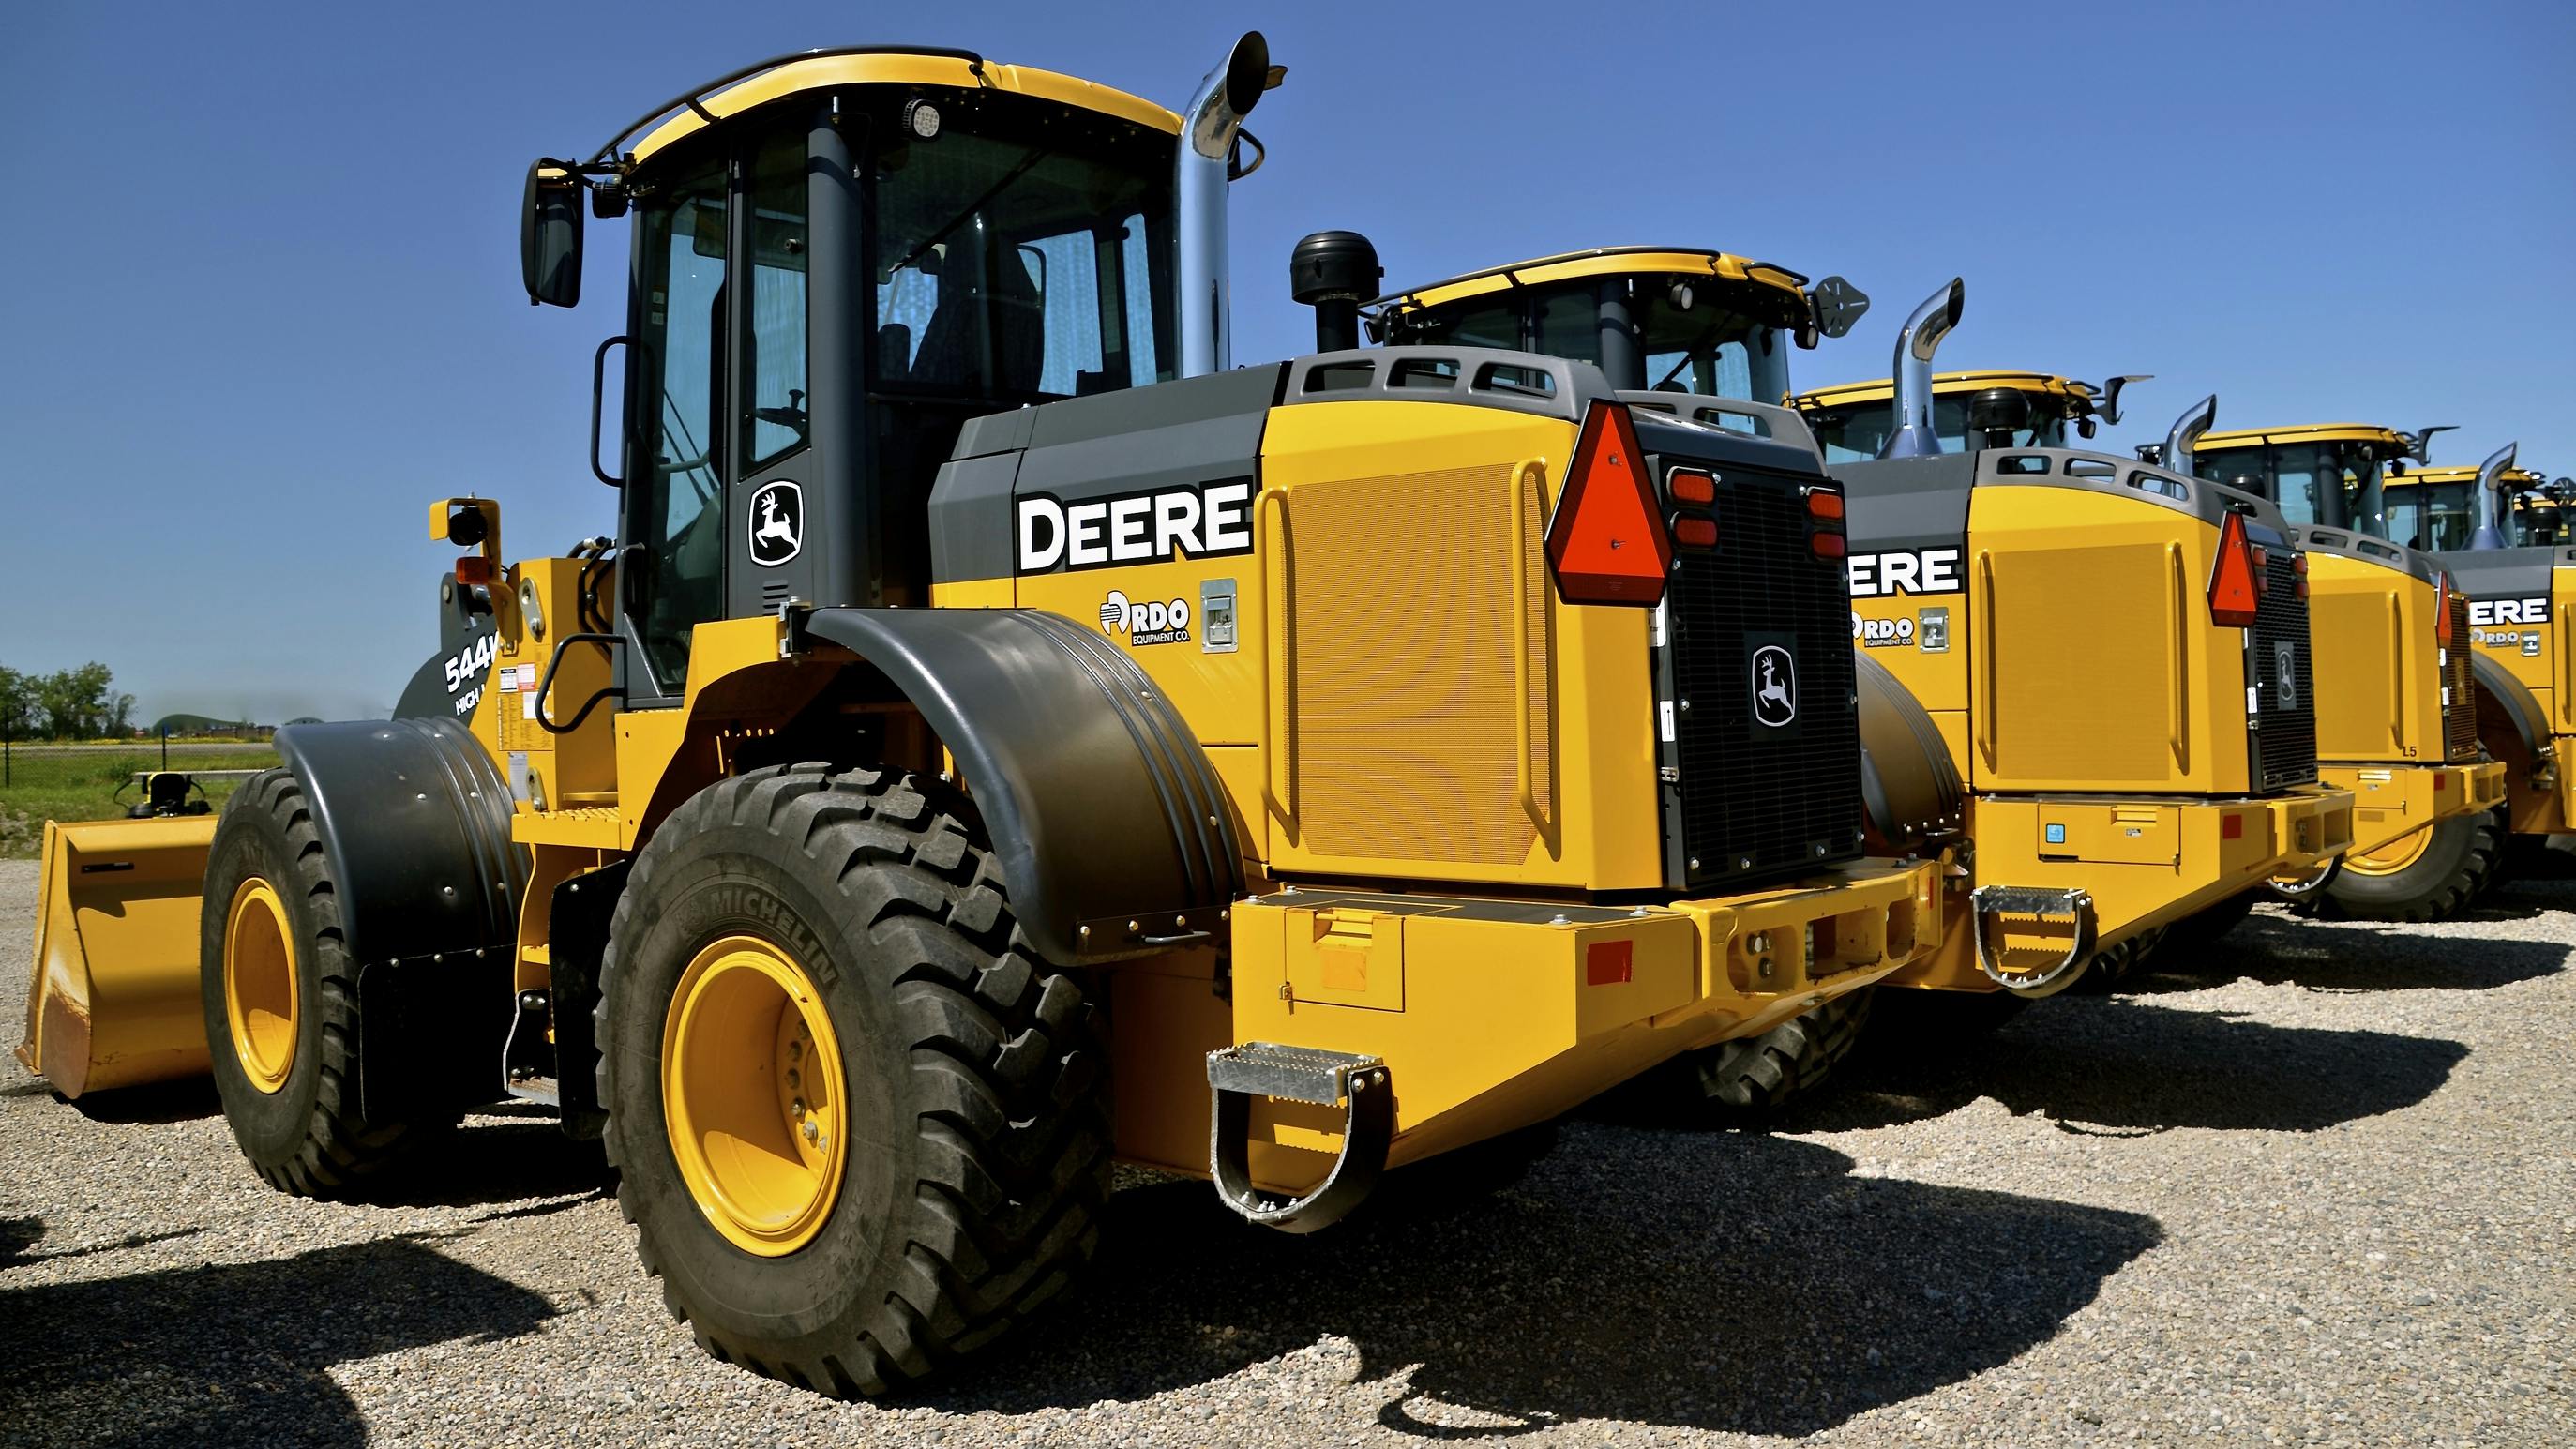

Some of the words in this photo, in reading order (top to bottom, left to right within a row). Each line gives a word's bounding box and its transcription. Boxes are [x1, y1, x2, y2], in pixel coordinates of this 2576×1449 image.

[1017, 483, 1250, 571] DEERE
[1133, 631, 1174, 645] EQUIPMENT
[1175, 630, 1190, 641] CO.
[455, 687, 480, 716] HIGH
[710, 887, 838, 986] MICHELIN
